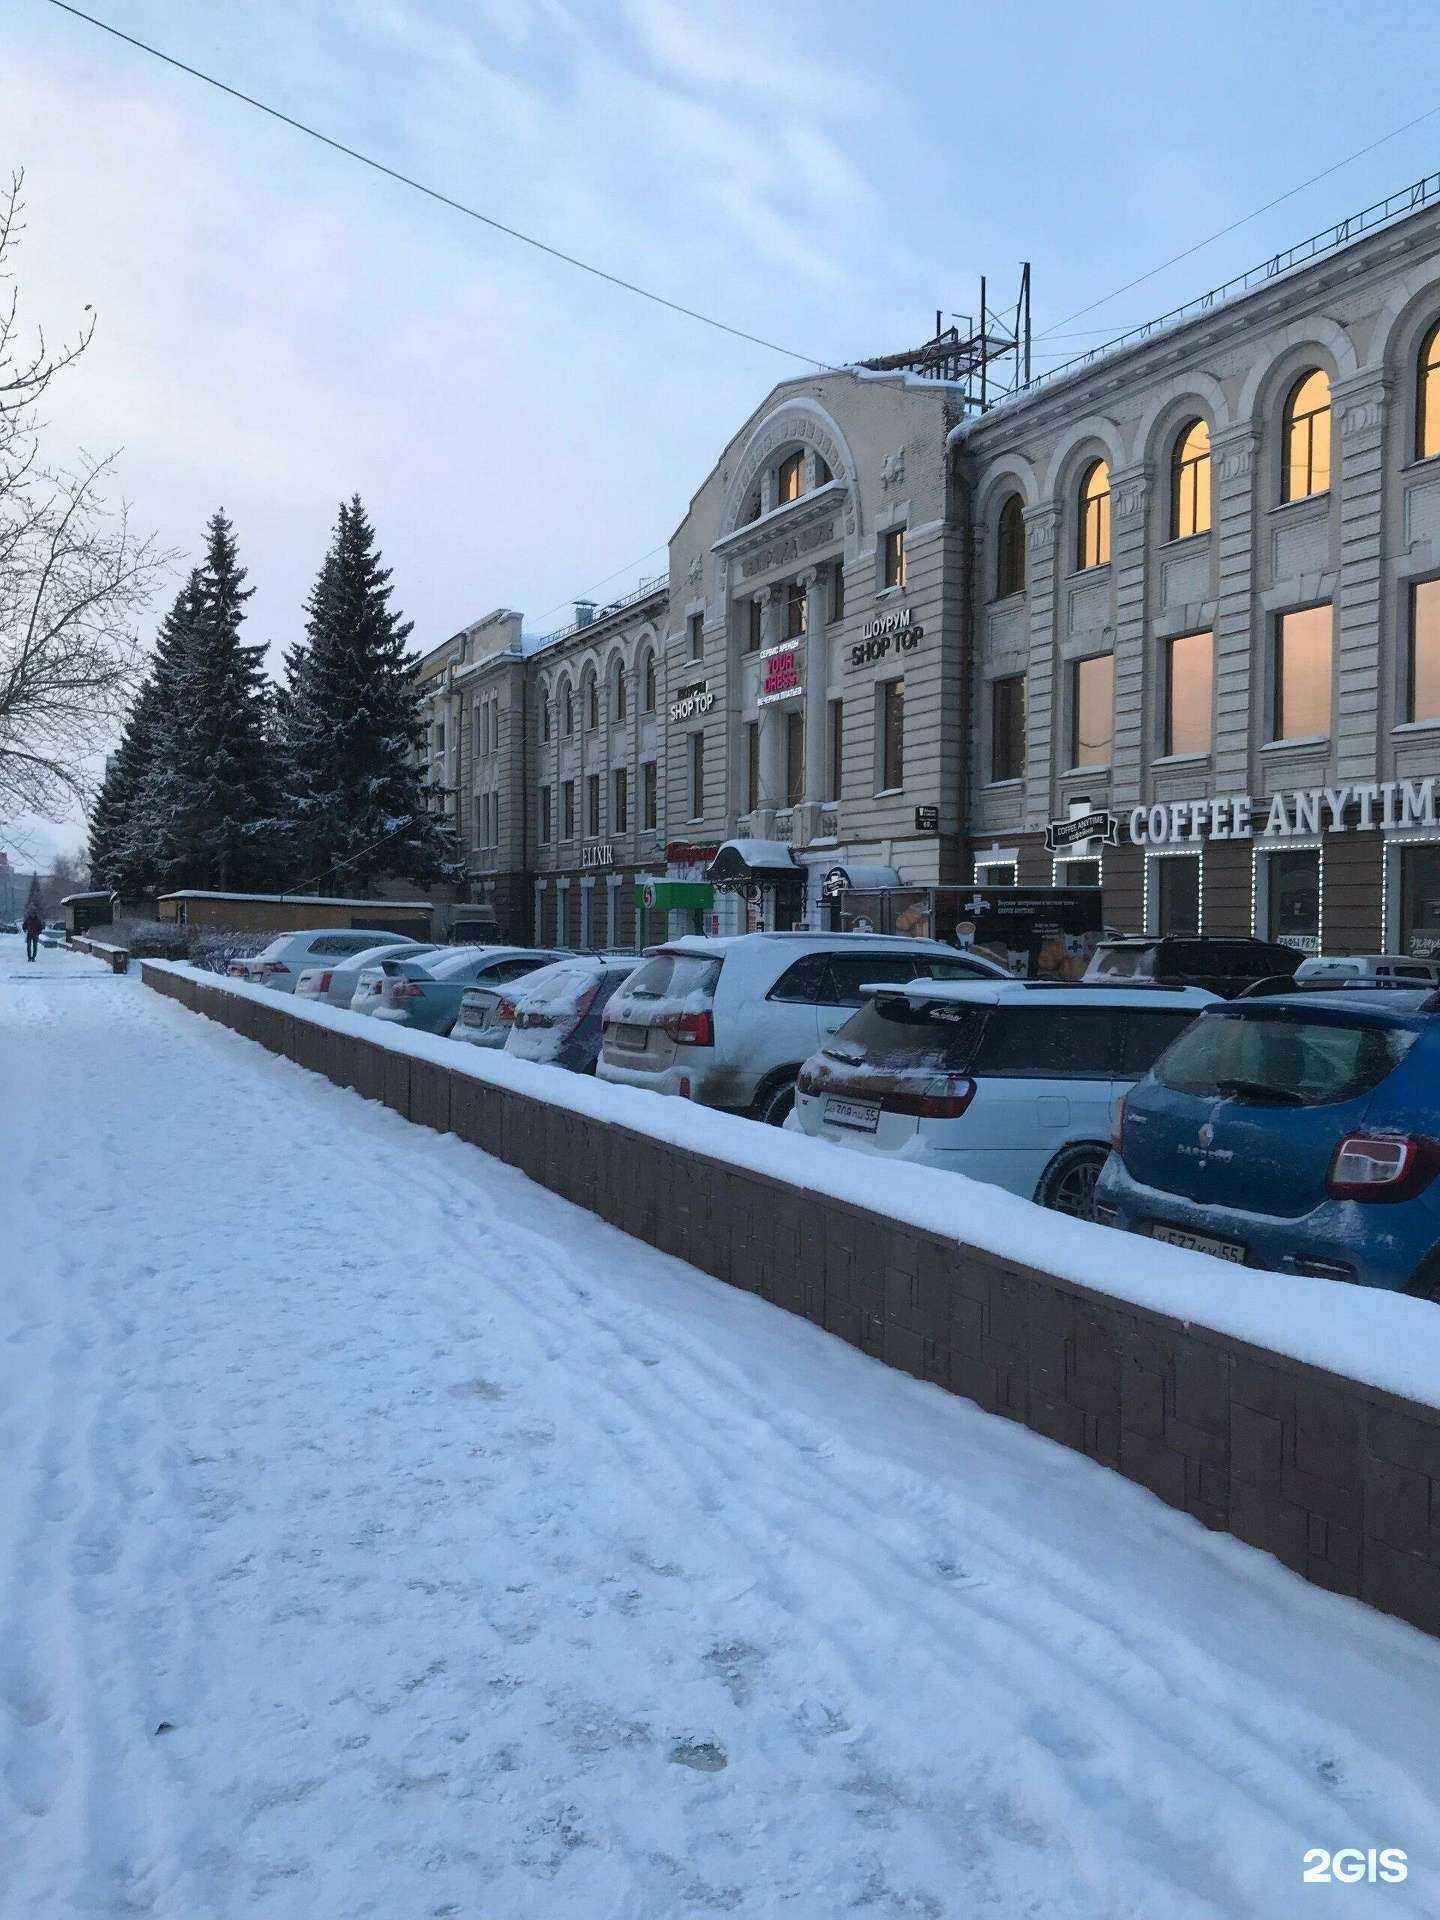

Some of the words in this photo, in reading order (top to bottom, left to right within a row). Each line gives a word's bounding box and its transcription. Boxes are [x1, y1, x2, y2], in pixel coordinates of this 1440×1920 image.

[864, 608, 911, 640] ШОУРУМ
[851, 637, 891, 665] SHOP
[894, 626, 924, 653] TOP
[767, 652, 794, 673] YOUR
[763, 671, 799, 693] DRESS
[671, 699, 694, 720] SHOP
[695, 692, 713, 714] TOP
[1129, 795, 1250, 846] COFFEE
[1264, 776, 1440, 837] ANYTIM
[1057, 823, 1078, 836] COFFEE
[1077, 815, 1104, 830] ANYTIME
[582, 845, 613, 867] ELIXIR
